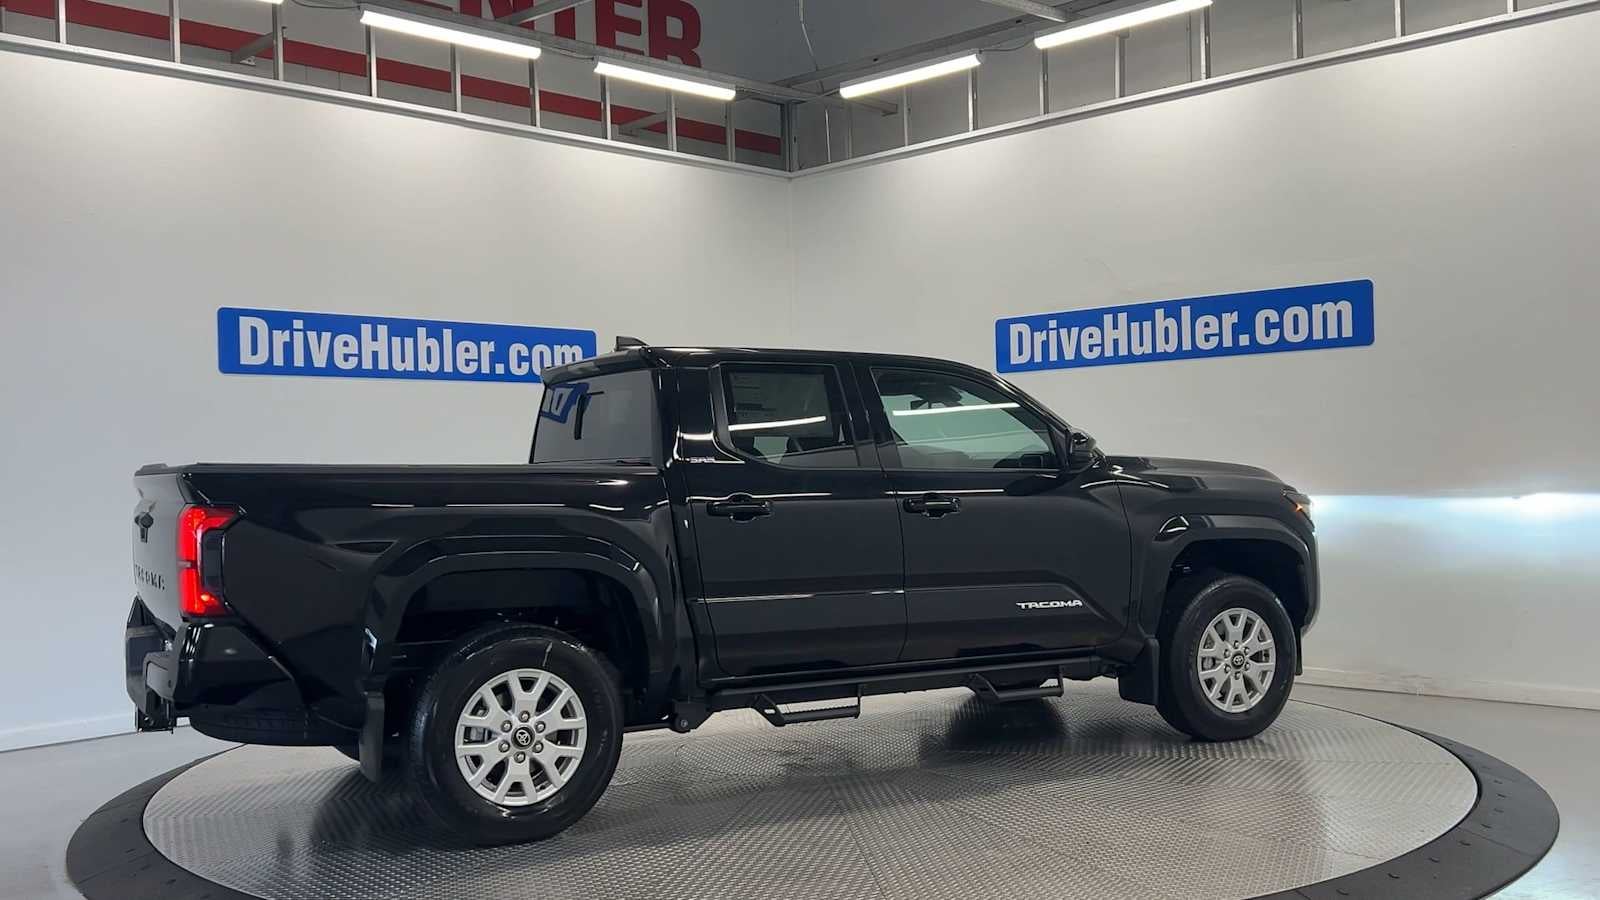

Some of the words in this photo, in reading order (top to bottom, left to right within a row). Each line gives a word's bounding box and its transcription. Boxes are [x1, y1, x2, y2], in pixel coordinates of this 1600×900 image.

[239, 316, 584, 376] DriveHubler.com
[1009, 299, 1353, 365] DriveHubler.com
[1016, 599, 1083, 609] TACOMA
